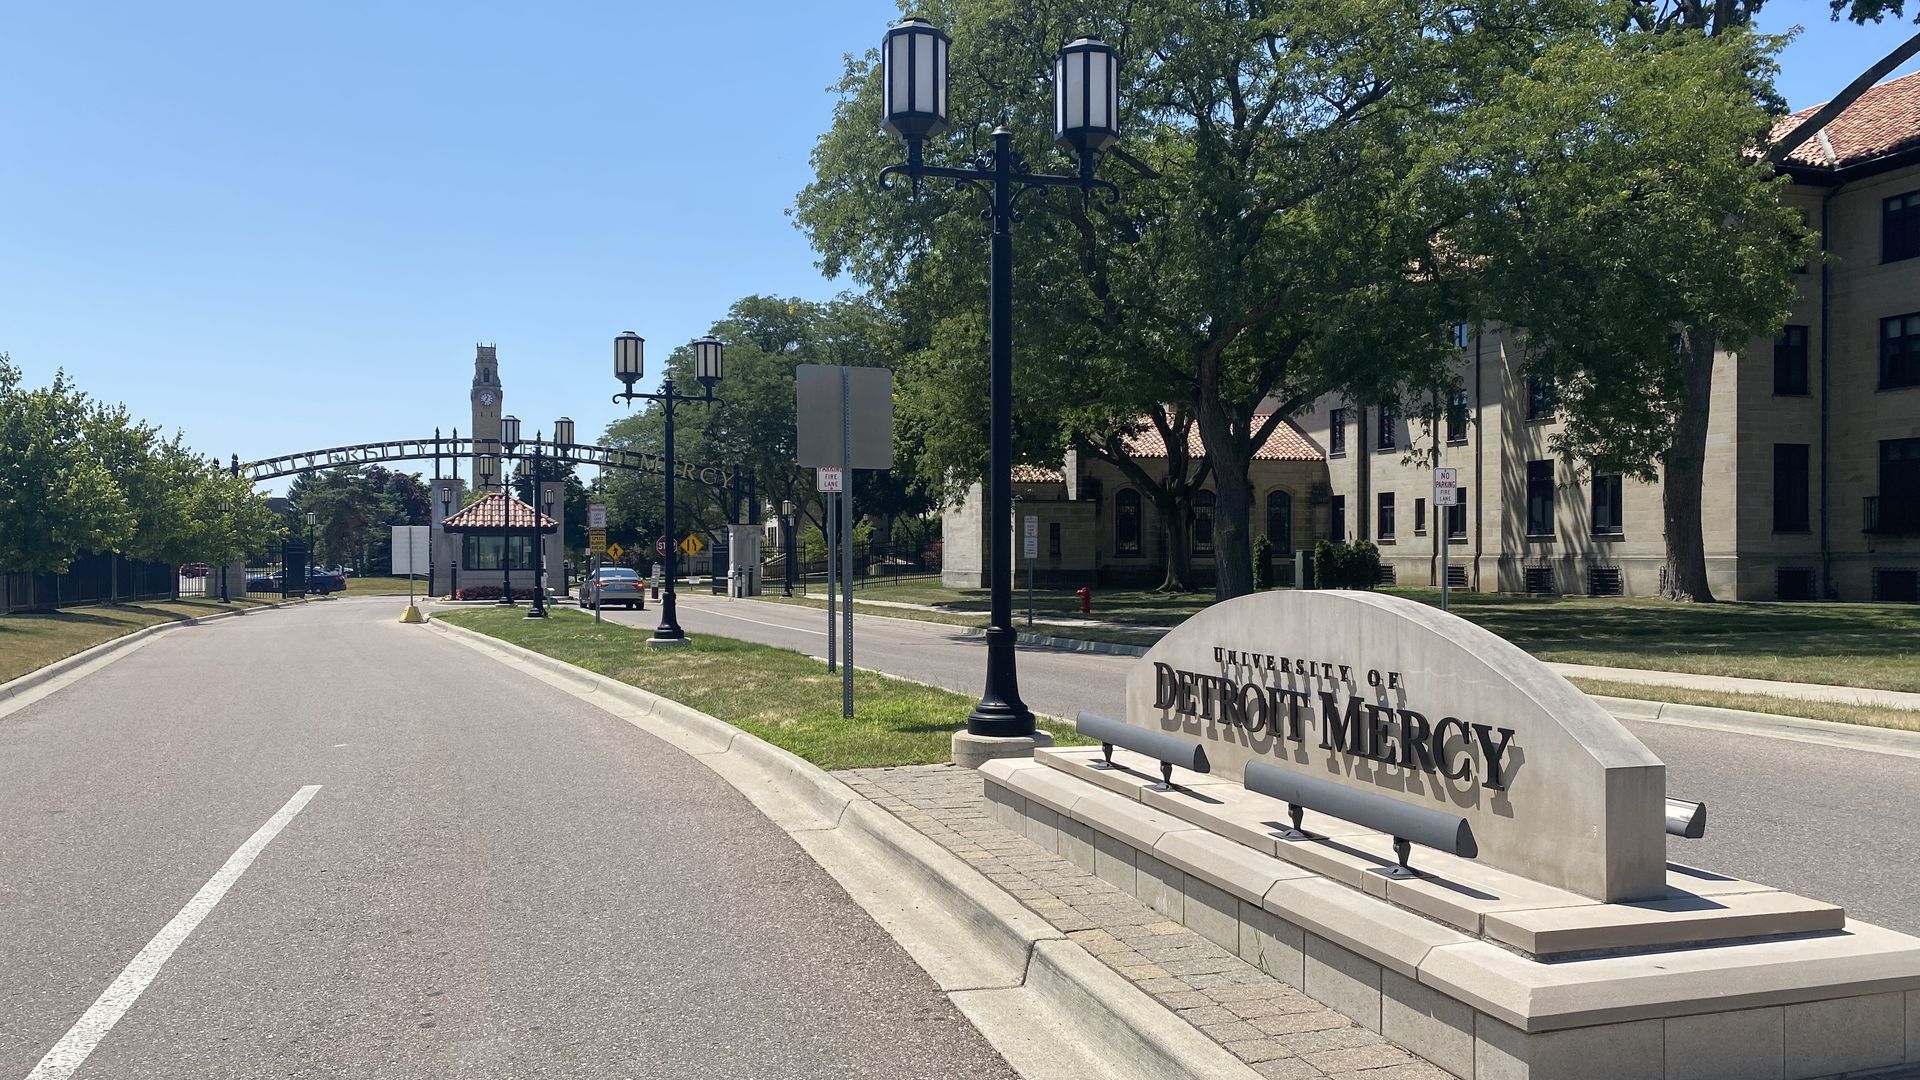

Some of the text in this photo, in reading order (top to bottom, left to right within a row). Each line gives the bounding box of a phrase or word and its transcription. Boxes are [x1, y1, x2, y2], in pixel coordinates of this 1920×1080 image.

[503, 440, 627, 466] ETOIT
[1213, 647, 1400, 690] UNIVERSITY OF
[1153, 662, 1515, 791] DETROIT MERCY
